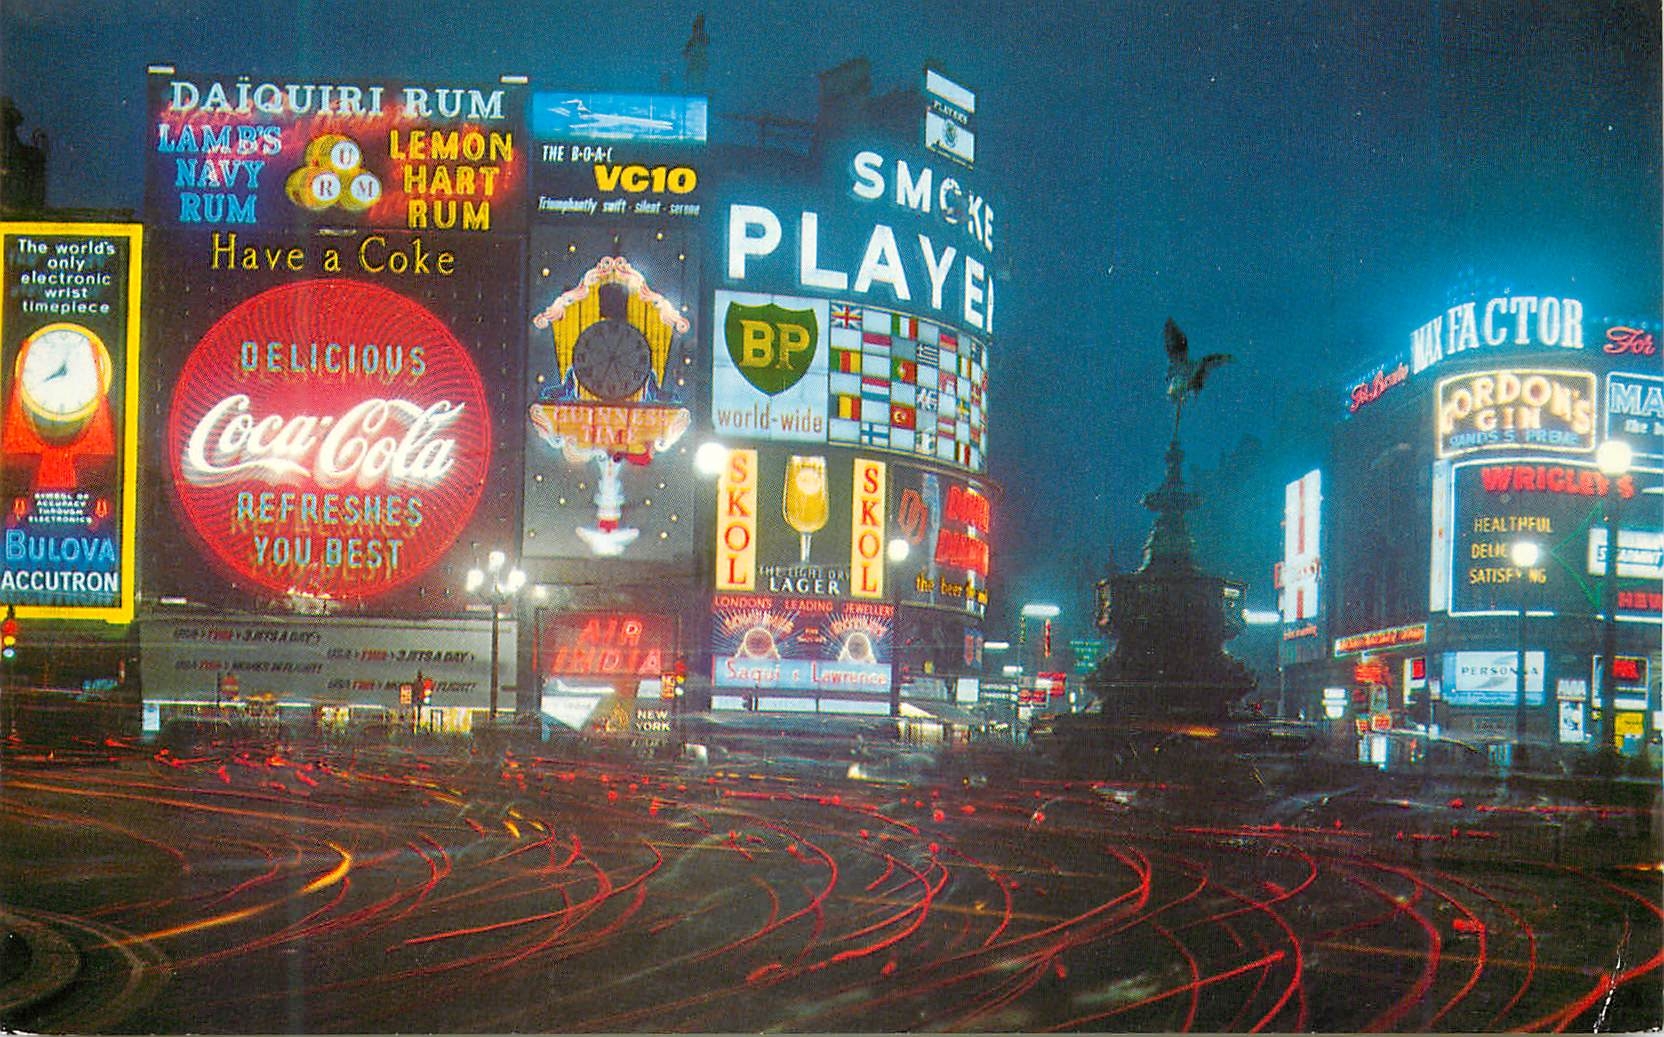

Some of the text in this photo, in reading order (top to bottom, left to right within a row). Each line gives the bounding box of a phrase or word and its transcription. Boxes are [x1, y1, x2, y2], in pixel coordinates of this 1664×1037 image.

[170, 76, 505, 119] DAÏQUIRI RUM
[158, 123, 282, 155] LAMB'S
[389, 130, 513, 162] LEMON
[542, 145, 564, 162] THE
[175, 158, 265, 188] NAVY
[404, 164, 500, 196] HART
[594, 164, 698, 194] VC10
[180, 192, 257, 224] RUM
[408, 199, 490, 231] RUM
[538, 195, 700, 217] Triumphantly swift silent serene
[852, 150, 994, 253] SMOKE
[18, 238, 116, 255] The world's
[211, 231, 455, 276] Have a Coke
[21, 270, 112, 286] electronic
[47, 254, 86, 272] only
[23, 300, 110, 315] timepiece
[45, 287, 88, 299] wrist
[738, 319, 810, 370] BP
[1409, 295, 1584, 376] MAX FACTOR
[1602, 326, 1656, 355] For
[239, 341, 427, 376] DELICIOUS
[717, 400, 823, 433] world-wide
[1475, 405, 1541, 431] GIN
[184, 393, 466, 484] Coca-Cola
[583, 424, 639, 443] TIME
[237, 491, 424, 528] REFRESHES
[724, 452, 751, 586] SKOL
[1473, 515, 1553, 533] HEALTHFUL
[5, 529, 116, 561] BULOVA
[858, 467, 881, 593] SKOL
[254, 535, 404, 570] YOU BEST
[1, 570, 119, 592] ACCUTRON
[760, 565, 781, 577] THE
[769, 577, 840, 596] LAGER
[785, 599, 834, 613] LEADING
[579, 618, 644, 646] AIR
[552, 645, 662, 675] INDIA
[725, 658, 781, 685] Saqui
[811, 660, 888, 685] Lawrence
[635, 720, 671, 732] YORK
[636, 708, 669, 720] NEW
